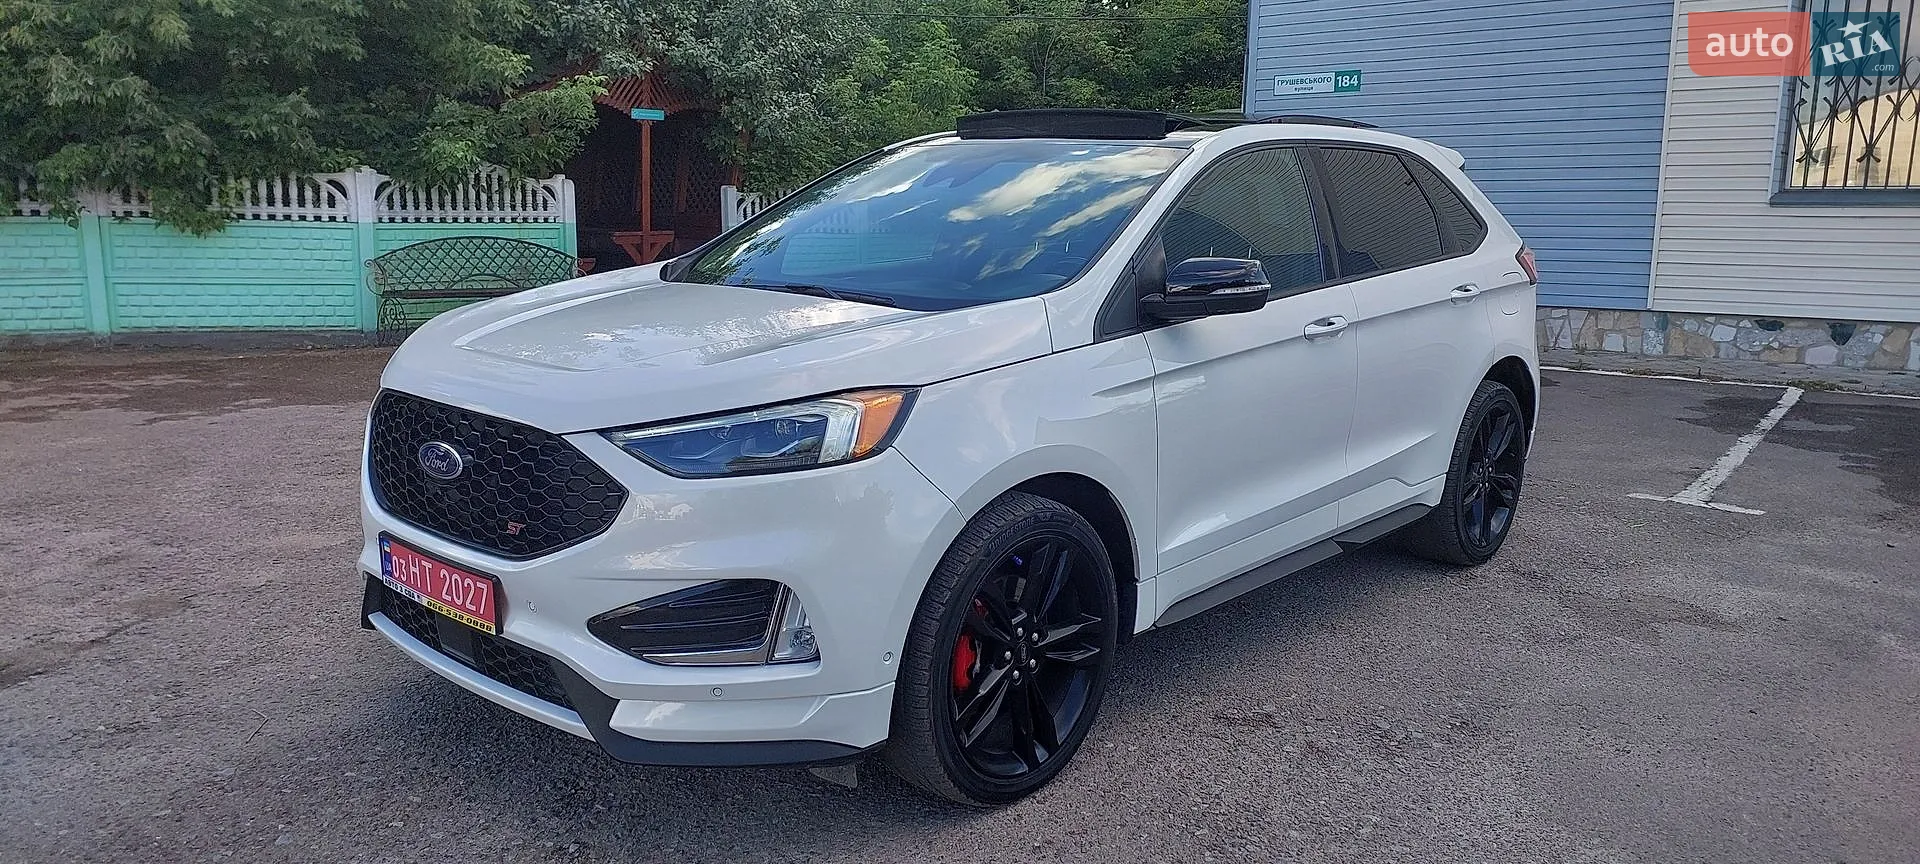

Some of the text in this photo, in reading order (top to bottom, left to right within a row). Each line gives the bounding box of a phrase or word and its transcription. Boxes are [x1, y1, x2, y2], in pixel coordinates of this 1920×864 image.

[1277, 75, 1359, 87] ГРУШЕВСЬКОГО 184
[425, 448, 450, 472] Ford
[505, 521, 526, 535] ST
[440, 568, 488, 615] 2027
